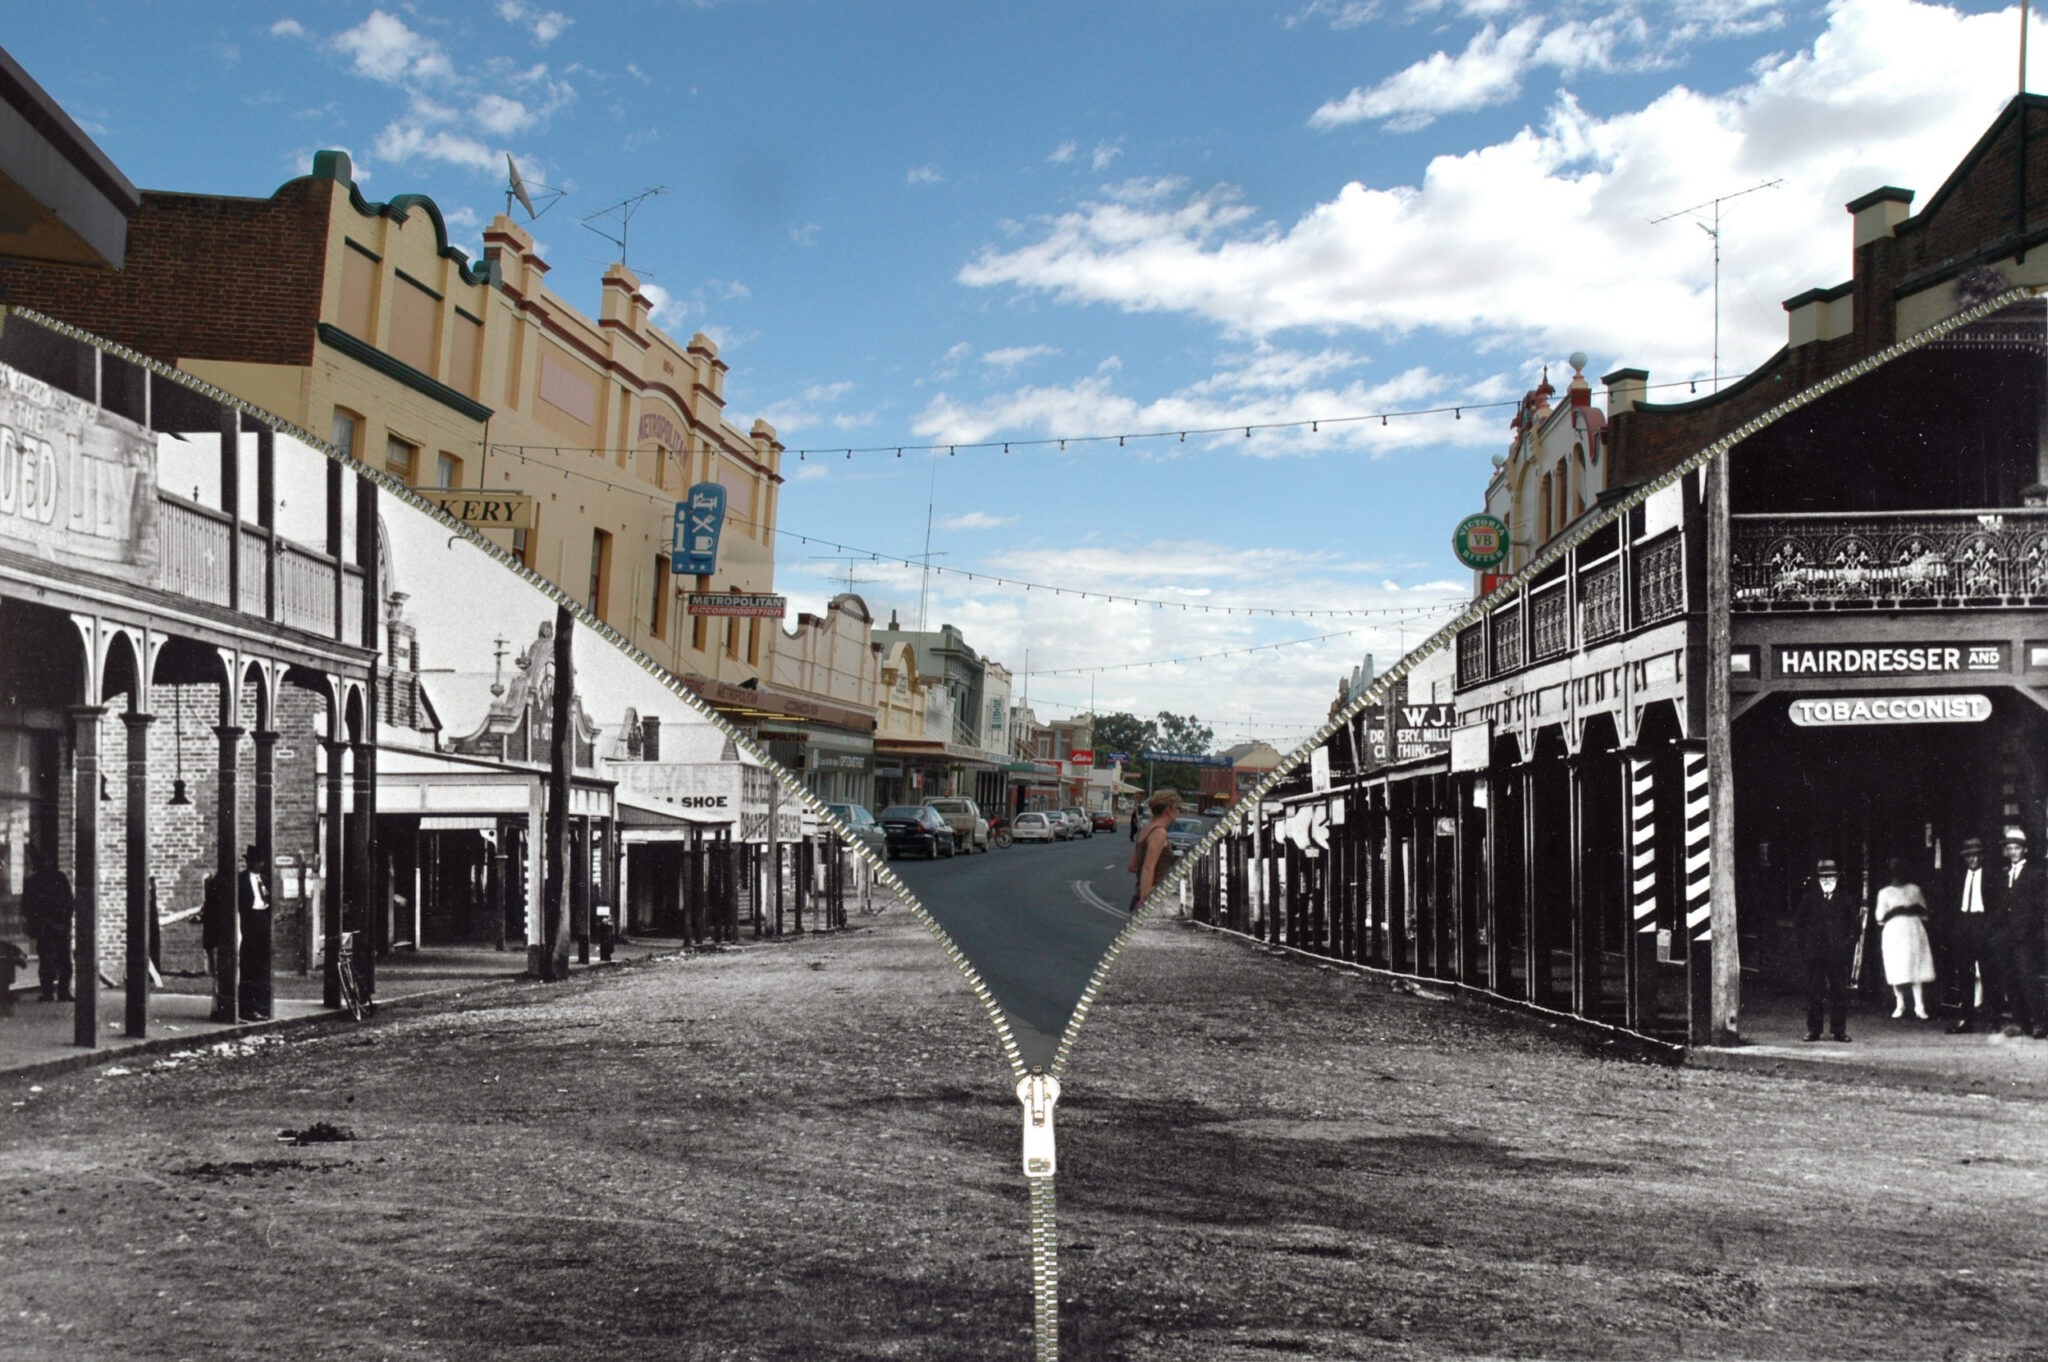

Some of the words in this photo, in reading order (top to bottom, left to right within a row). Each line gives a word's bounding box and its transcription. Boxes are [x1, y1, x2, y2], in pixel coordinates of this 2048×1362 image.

[639, 413, 688, 468] METROPOLITAN
[1459, 519, 1505, 536] VICTORIA
[1474, 534, 1493, 546] VB
[1462, 550, 1503, 562] BITTER
[691, 596, 782, 606] METROPOLITAN
[690, 606, 782, 616] ACCOMMODATION
[1781, 648, 1960, 673] HAIRDRESSER
[1968, 650, 2000, 666] AND
[1799, 698, 1983, 721] TOBACCONIST
[1370, 729, 1421, 744] DRERY.
[681, 796, 728, 808] SHOE
